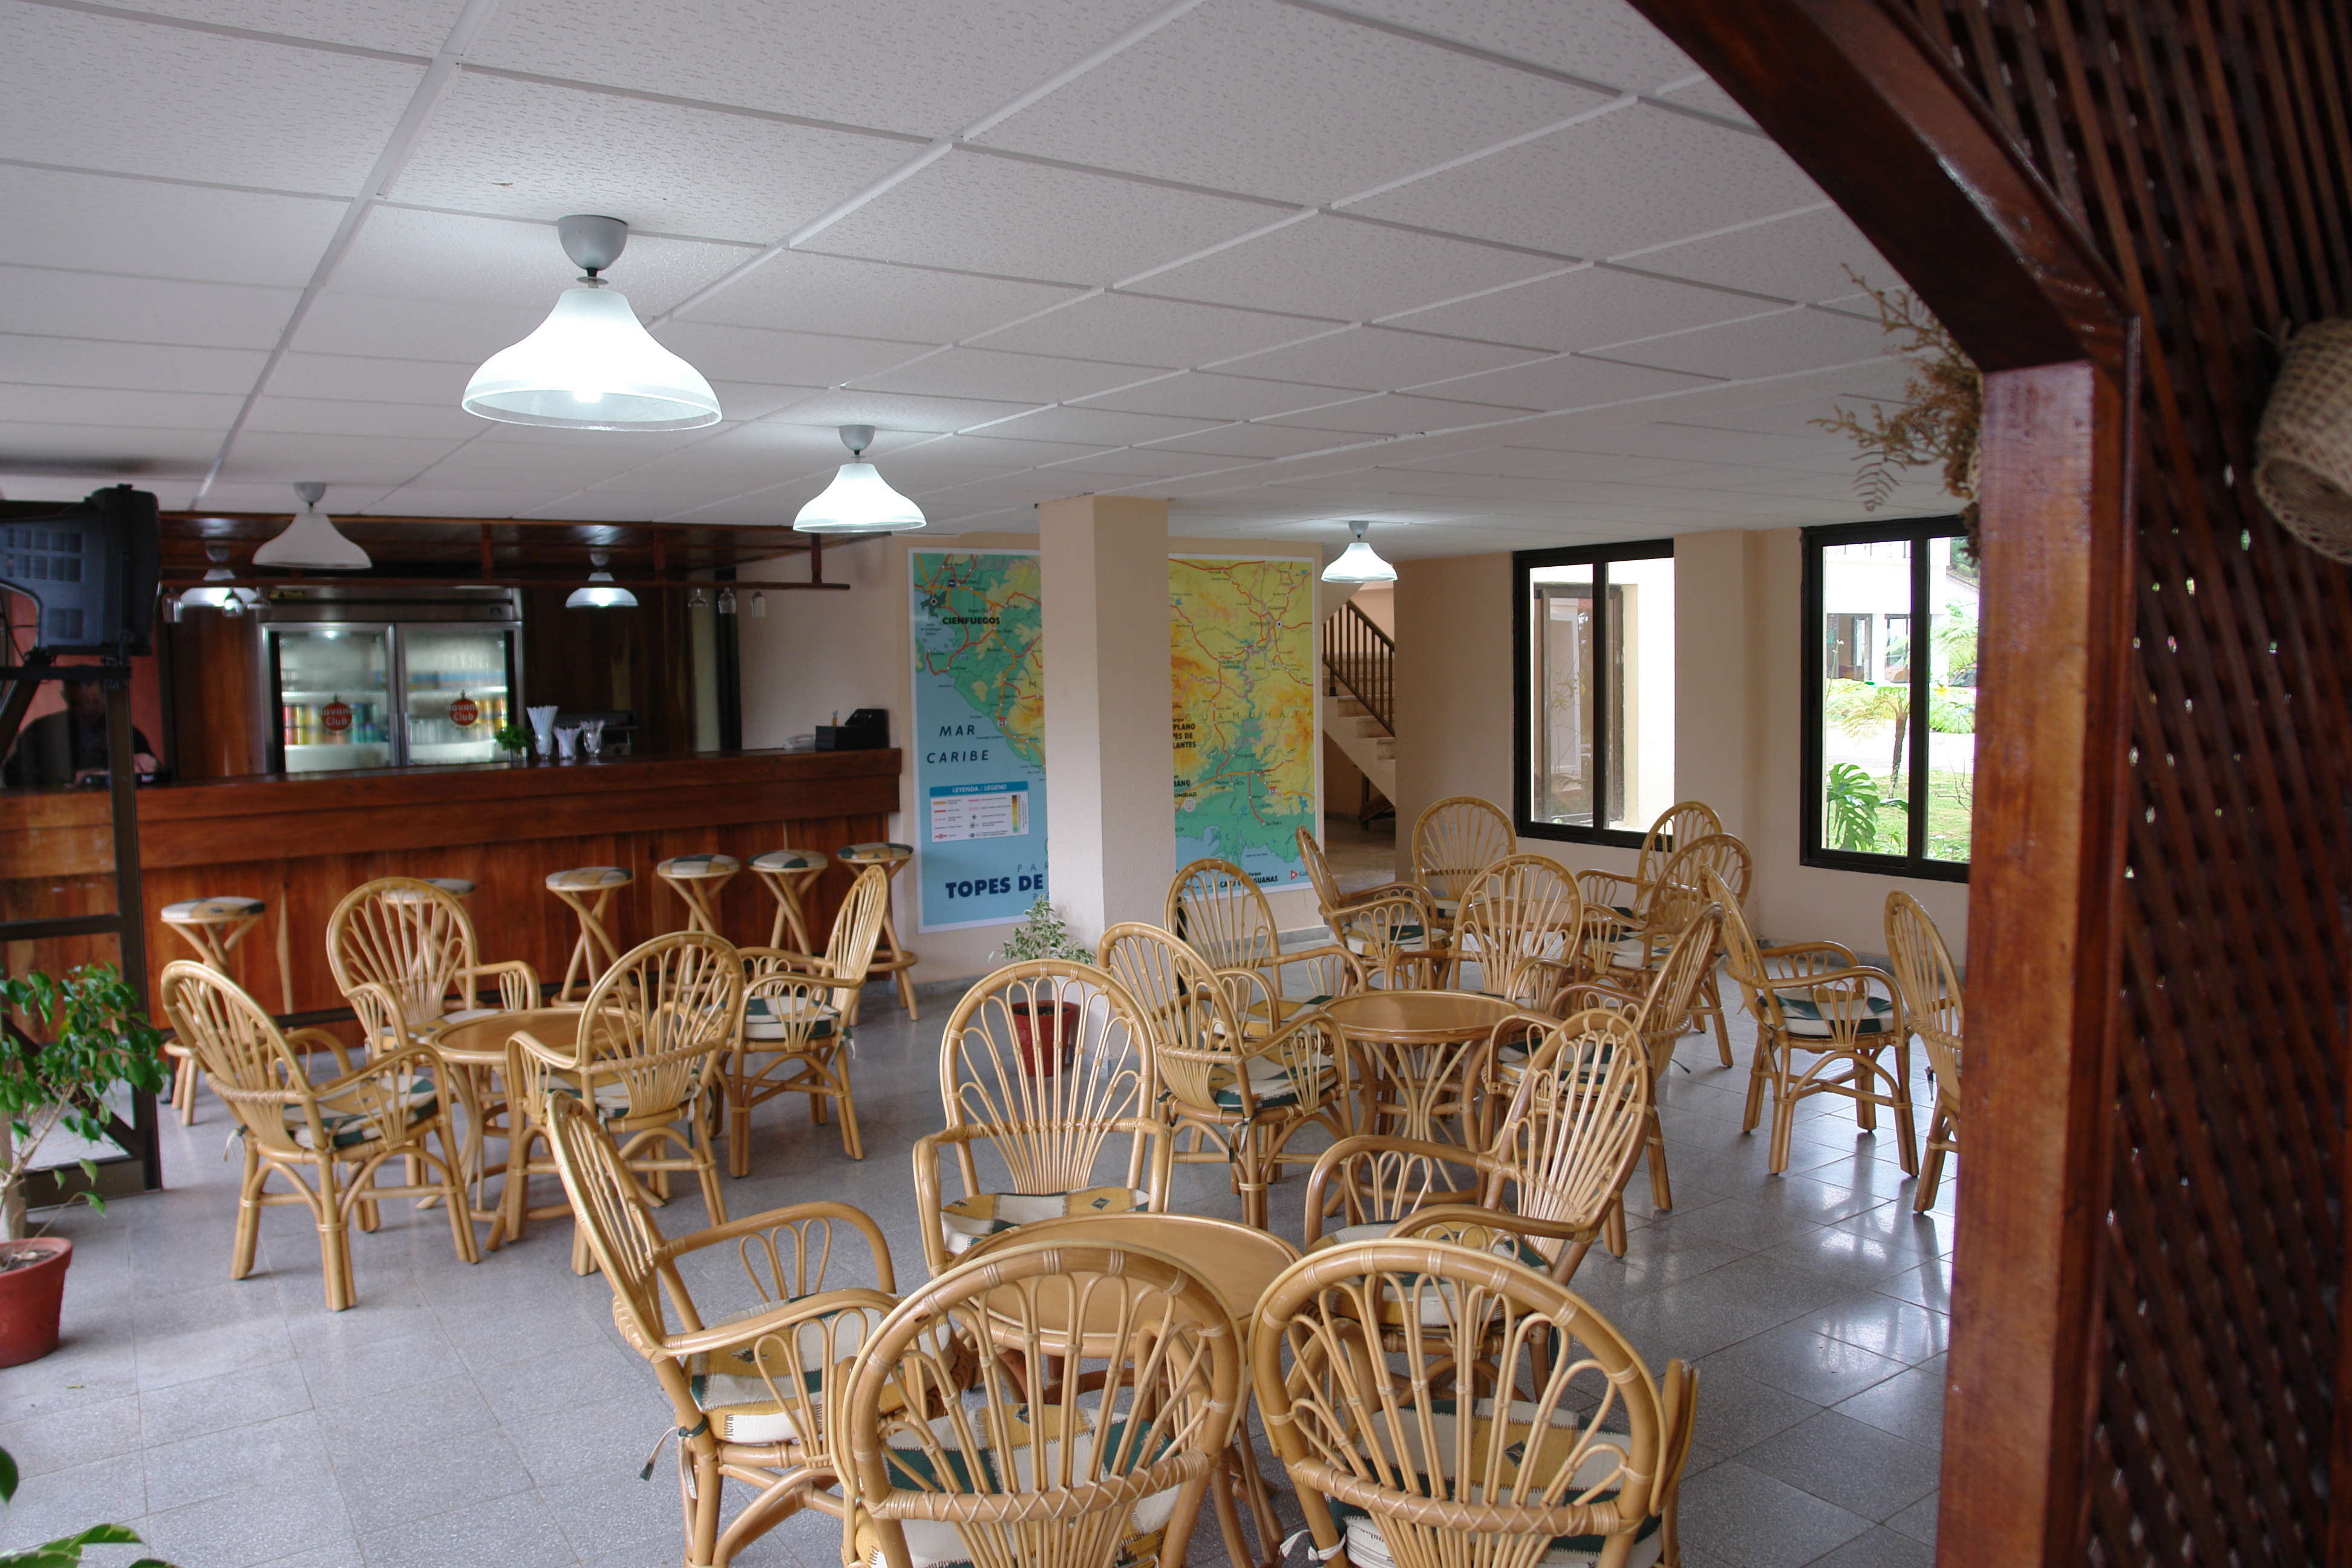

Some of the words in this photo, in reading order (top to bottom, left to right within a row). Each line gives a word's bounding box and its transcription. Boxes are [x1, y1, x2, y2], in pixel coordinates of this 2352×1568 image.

[942, 616, 1001, 625] CIENFUEGOS
[325, 716, 347, 726] Club
[454, 712, 474, 721] Club
[939, 725, 976, 737] MAR
[927, 750, 990, 764] CARIBE
[946, 877, 1011, 898] TOPES
[1019, 873, 1044, 892] DE
